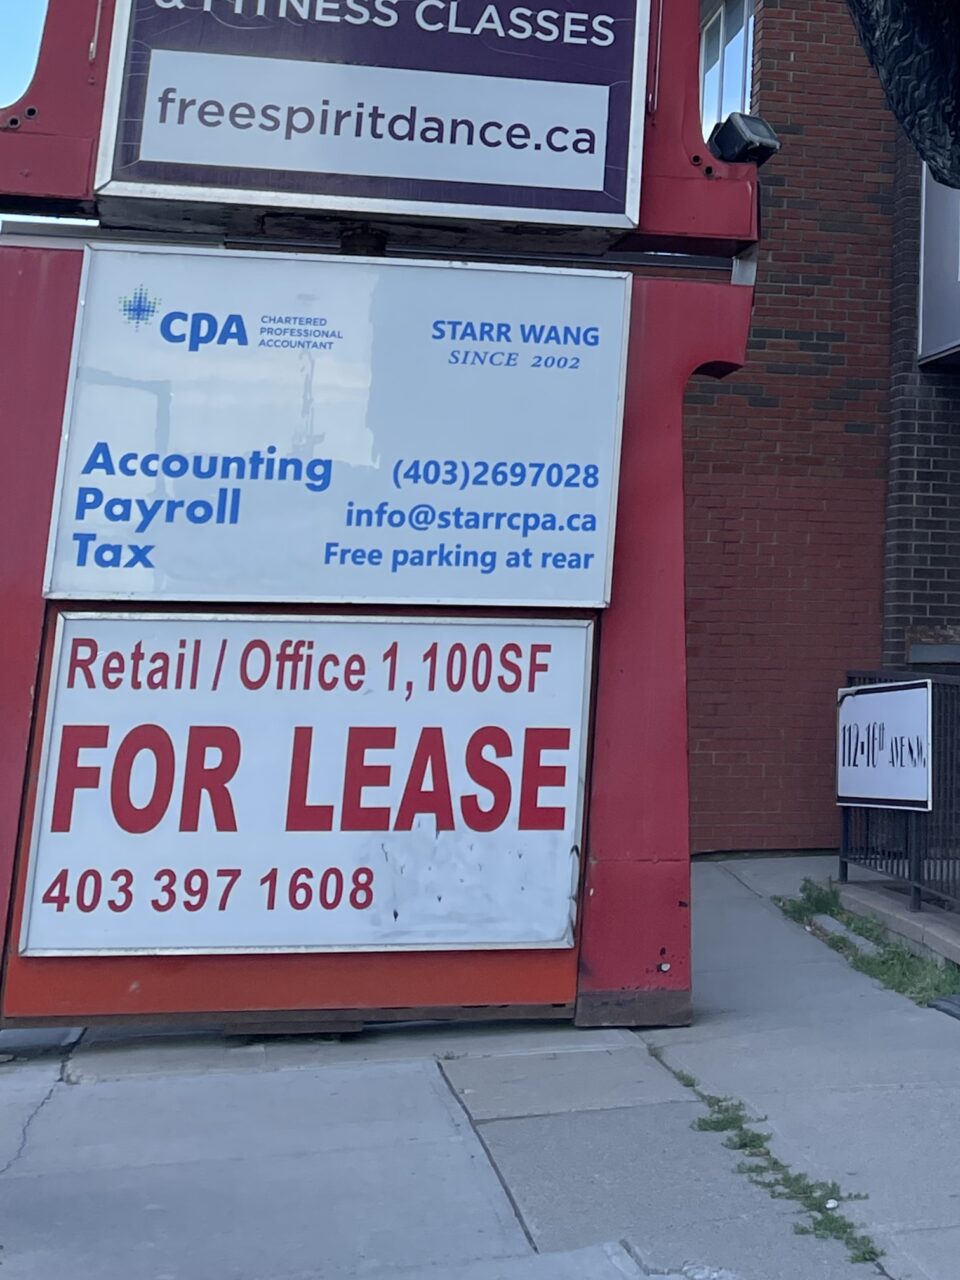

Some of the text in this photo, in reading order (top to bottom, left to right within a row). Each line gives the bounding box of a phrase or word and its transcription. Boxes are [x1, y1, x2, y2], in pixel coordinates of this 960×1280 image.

[157, 88, 597, 156] freespiritdance.ca
[260, 327, 343, 339] PROFESSIONAL
[261, 316, 327, 326] CHARTERED
[432, 319, 600, 346] STARR WANG
[258, 339, 333, 350] ACCOUNTANT
[448, 349, 581, 370] SINCE 2002
[81, 442, 333, 490] Accounting
[392, 458, 600, 490] (403)2697028
[75, 486, 241, 533] Payroll
[346, 503, 597, 538] info@starrcpa.ca
[72, 533, 155, 569] Tax
[324, 542, 594, 574] Free parking at rear
[67, 638, 202, 691] Retail
[240, 640, 365, 691] Office
[381, 642, 552, 700] 1,100SF
[50, 725, 571, 834] FOR LEASE
[42, 867, 374, 913] 403 397 1608
